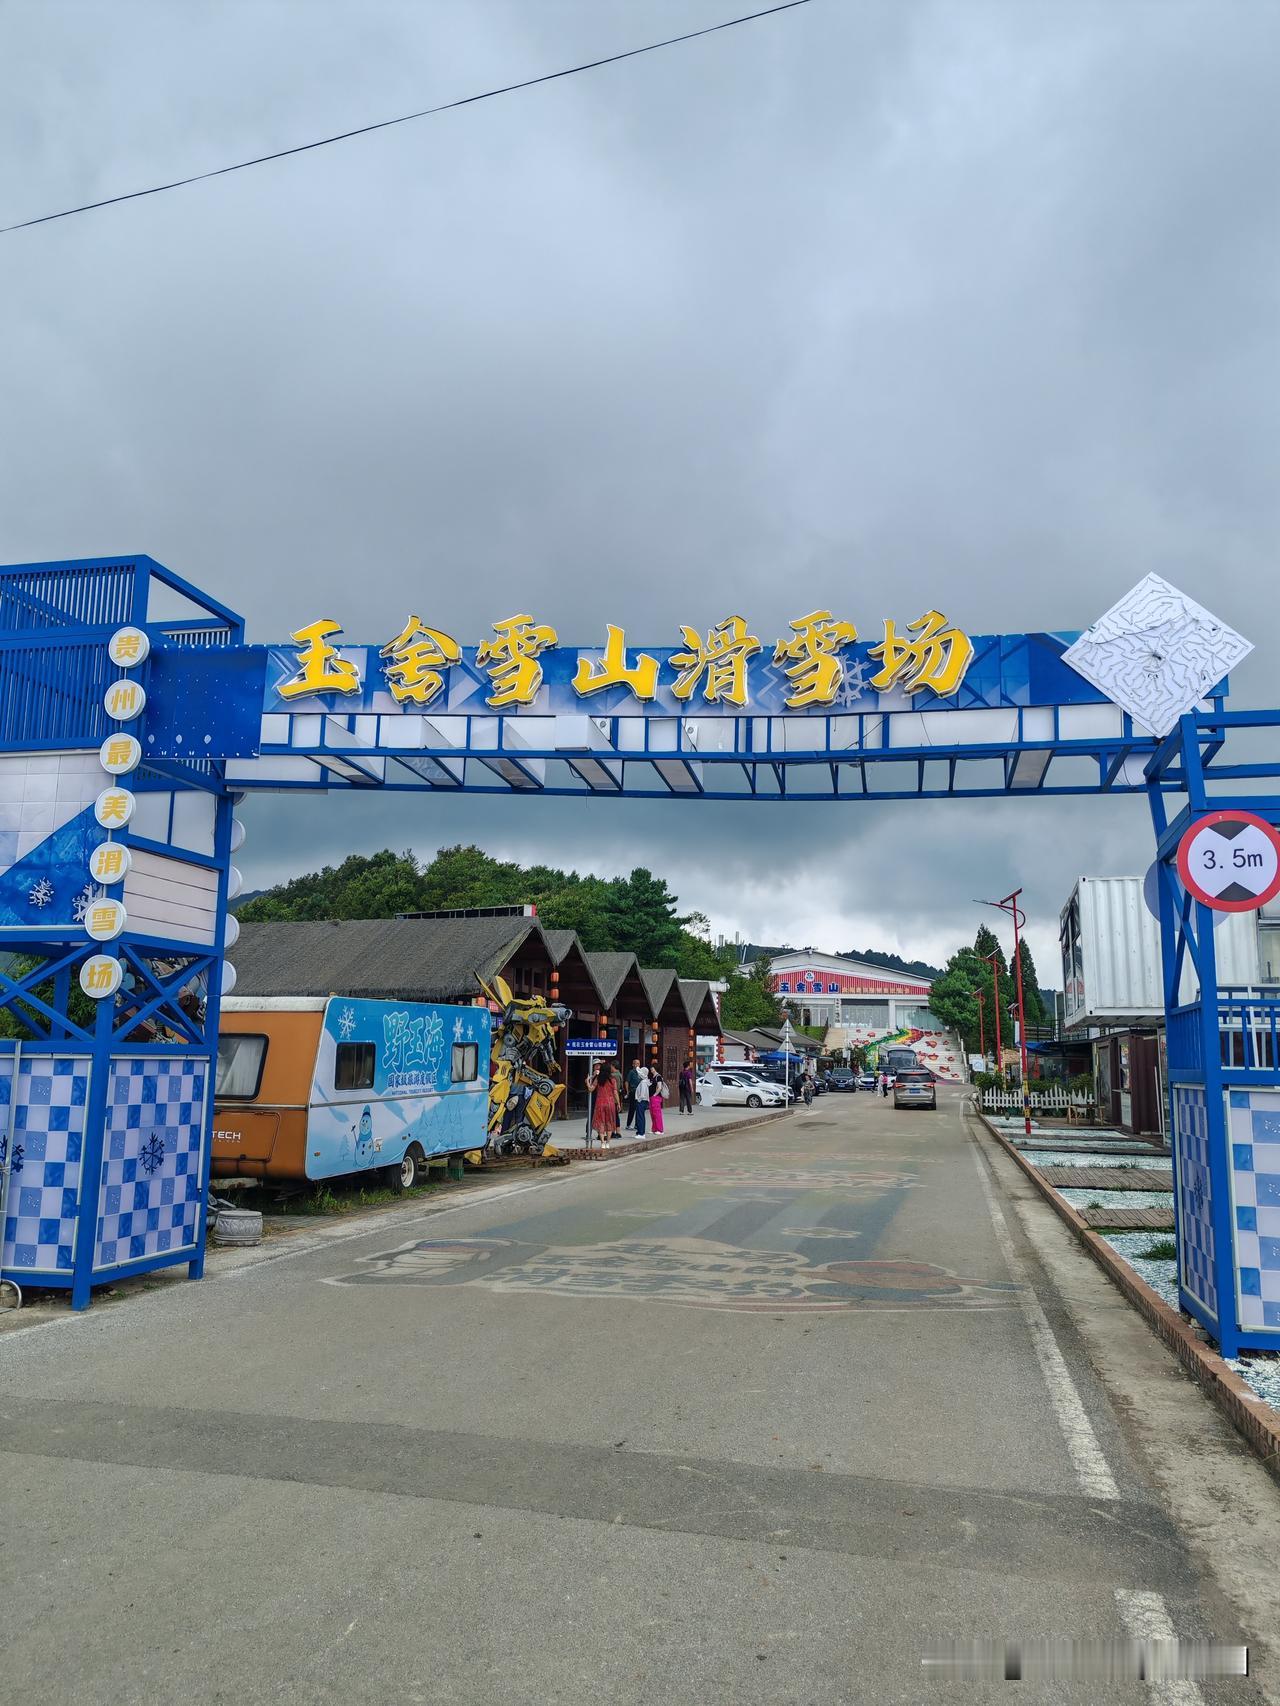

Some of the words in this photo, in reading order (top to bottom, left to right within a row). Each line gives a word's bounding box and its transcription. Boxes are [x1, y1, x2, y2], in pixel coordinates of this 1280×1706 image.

[277, 610, 975, 709] 玉舍雪山滑雪场
[87, 634, 142, 987] 贵州最美滑雪场
[1203, 848, 1263, 869] 3.5m
[382, 1011, 445, 1075] 野玉海
